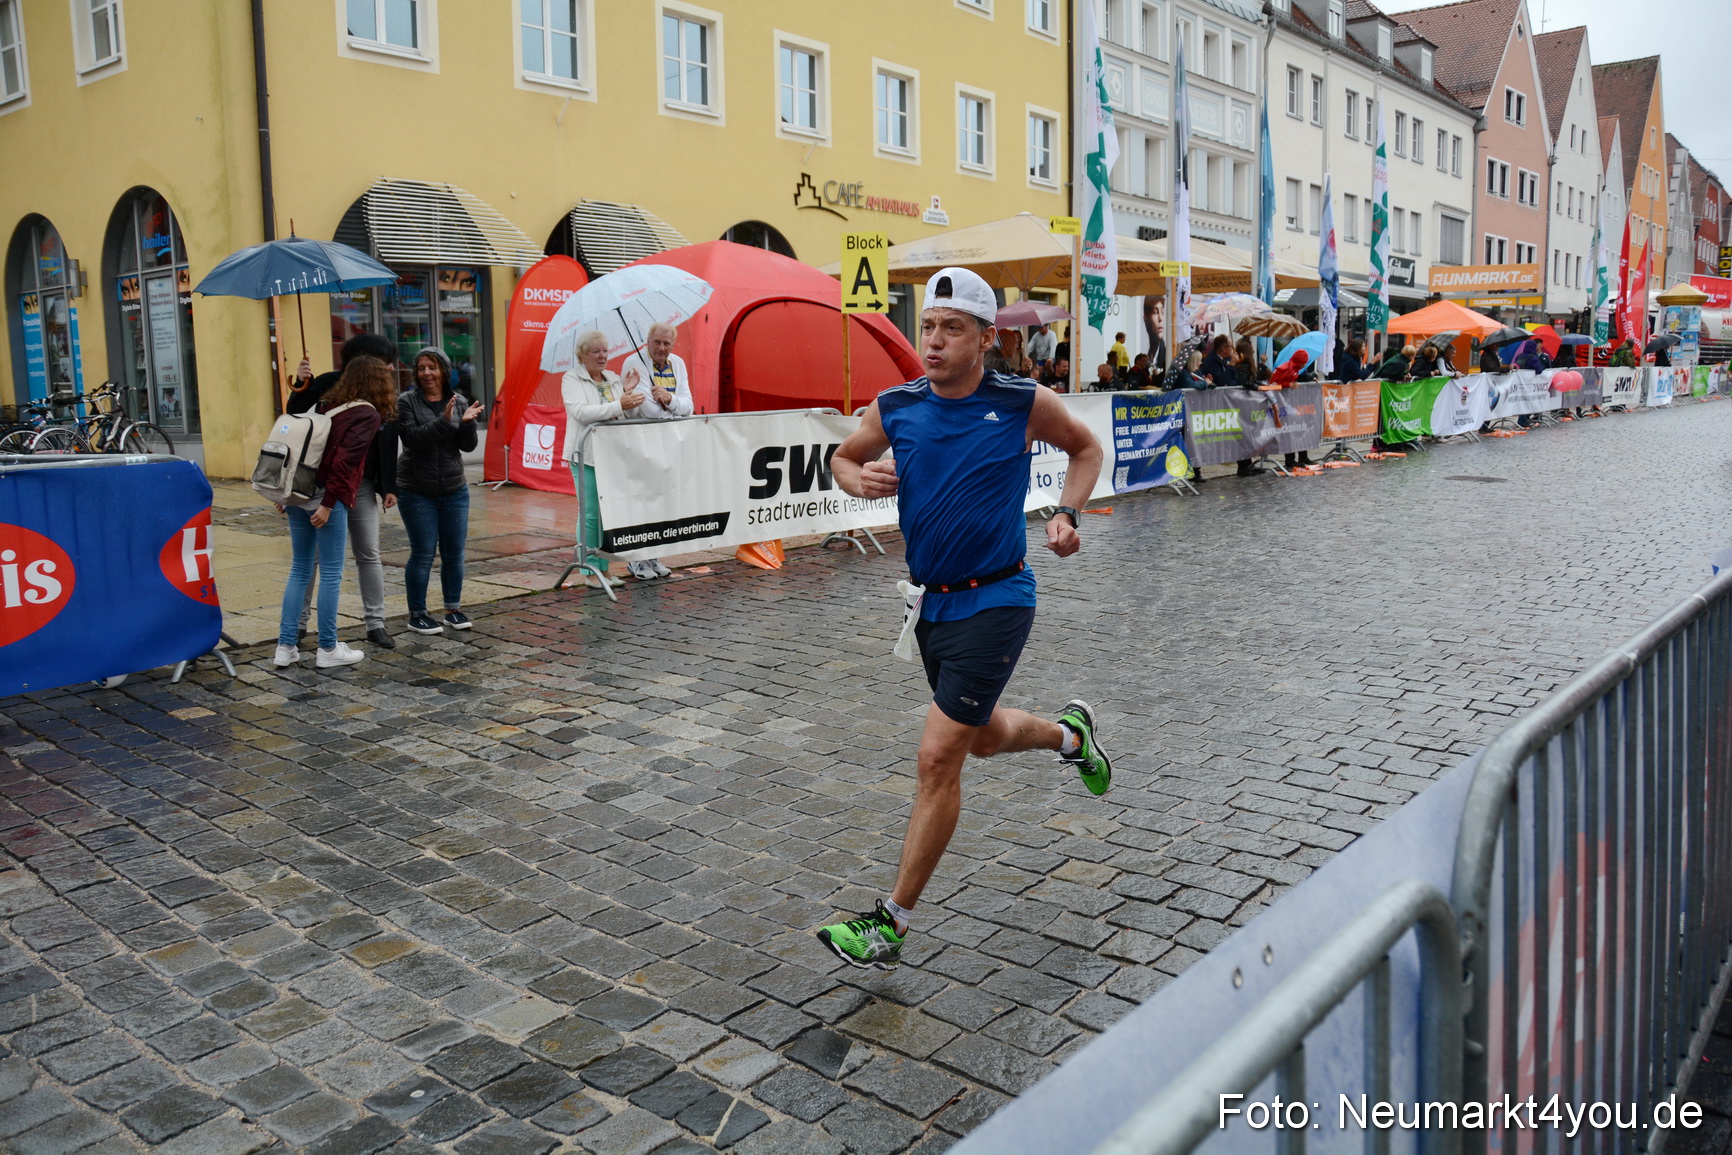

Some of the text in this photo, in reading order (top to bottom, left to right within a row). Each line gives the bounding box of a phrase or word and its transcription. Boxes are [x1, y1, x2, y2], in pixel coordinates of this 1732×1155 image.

[882, 198, 920, 217] RATHAUS
[846, 235, 883, 250] Block
[1084, 250, 1106, 260] Miets
[851, 256, 878, 295] A
[523, 288, 562, 302] DKMS
[1115, 407, 1128, 421] WIR
[1131, 404, 1162, 420] SUCHEN
[1192, 411, 1240, 433] BOCK
[1116, 438, 1133, 448] UNTER
[525, 451, 550, 466] DKMS
[748, 443, 842, 500] SW
[1036, 471, 1053, 488] to
[748, 496, 898, 526] stadtwerke neumark
[613, 521, 719, 547] Leistungen, die verbinden
